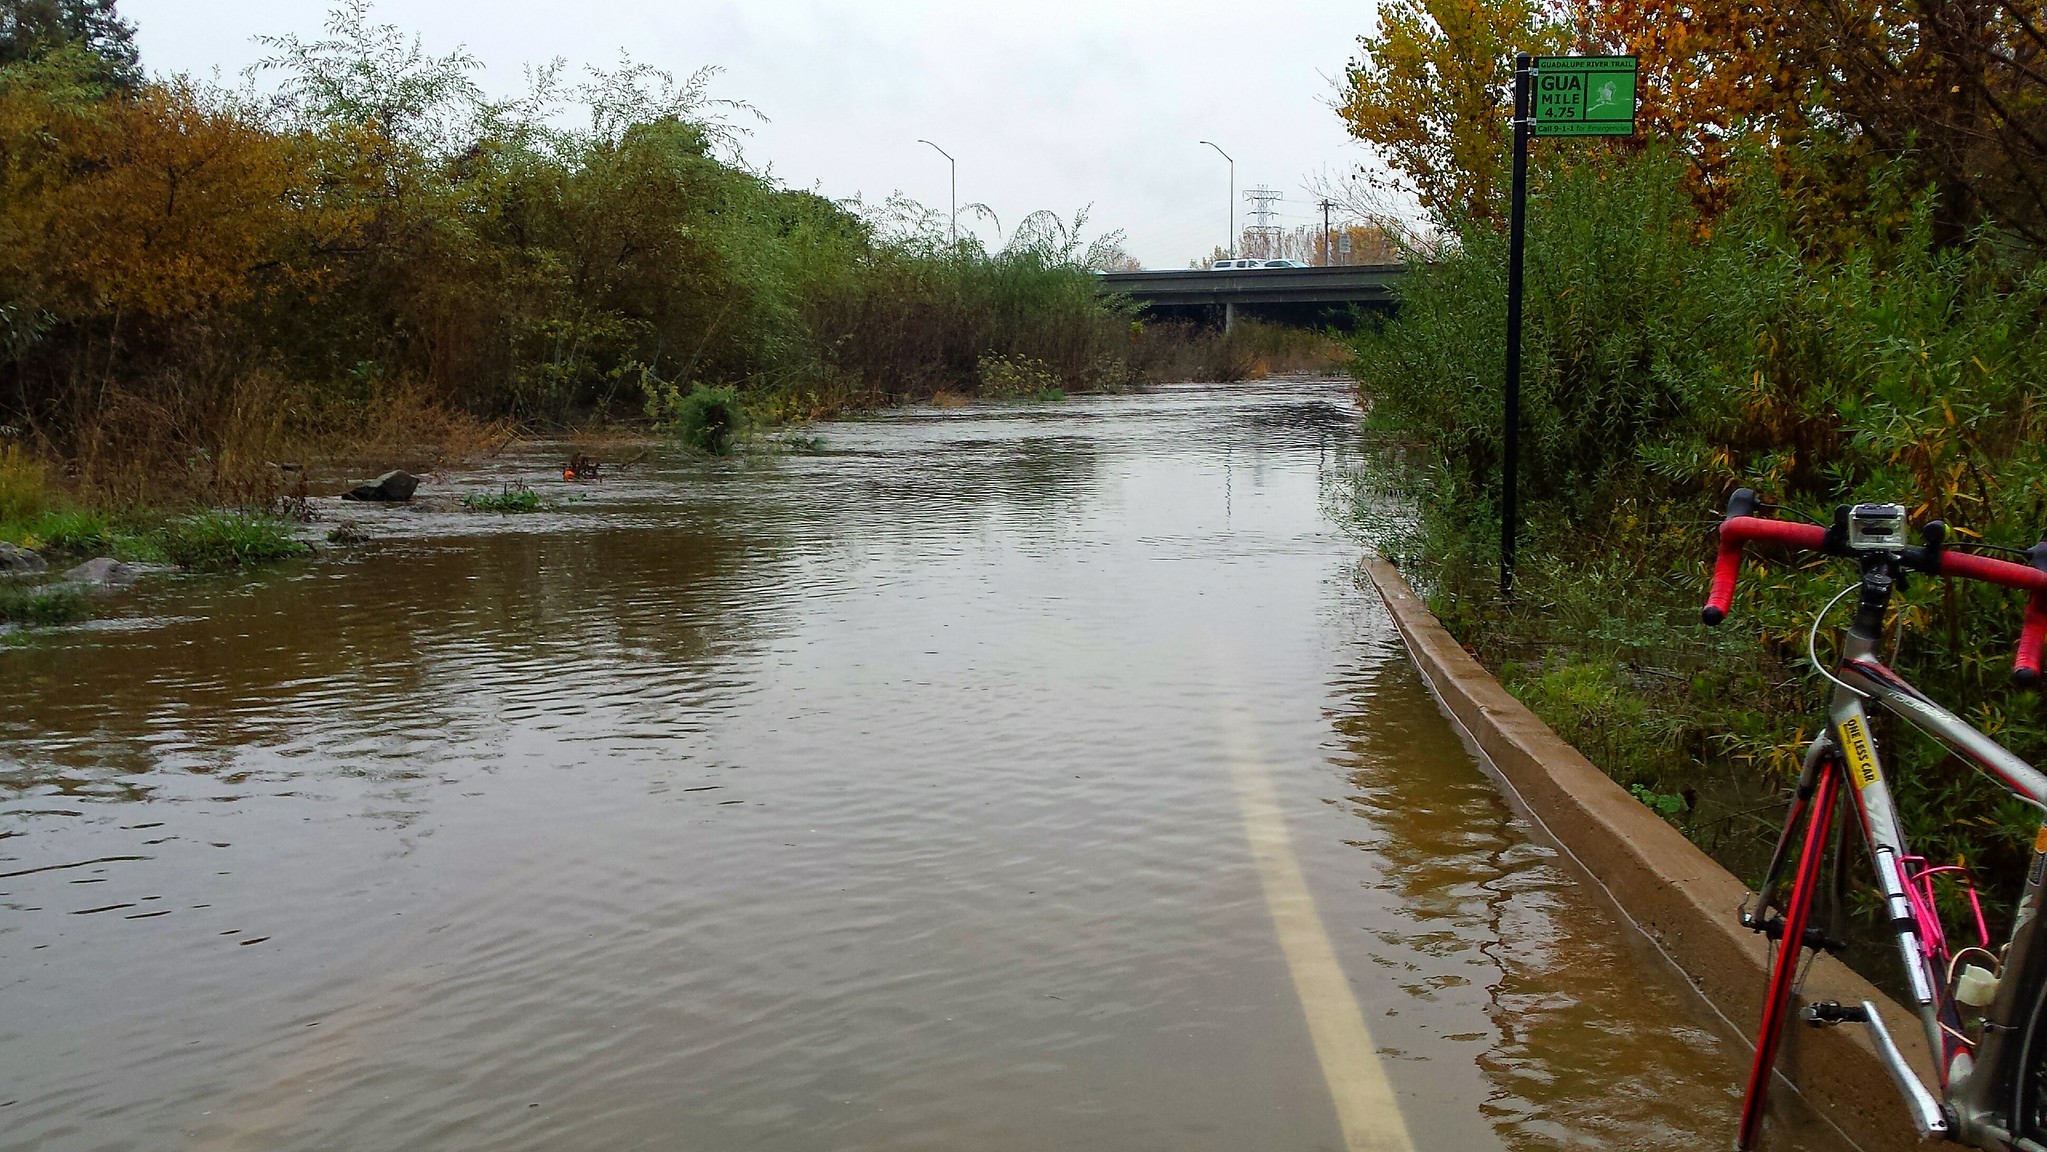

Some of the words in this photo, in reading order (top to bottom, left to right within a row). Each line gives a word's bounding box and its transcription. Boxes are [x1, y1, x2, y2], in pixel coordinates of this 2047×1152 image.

[1541, 75, 1581, 91] GUA
[1542, 93, 1580, 104] MILE
[1544, 107, 1575, 118] 4.75
[1588, 125, 1630, 133] Emergencies
[1848, 718, 1861, 739] ONE
[1853, 739, 1869, 761] LESS
[1861, 762, 1875, 782] CAR
